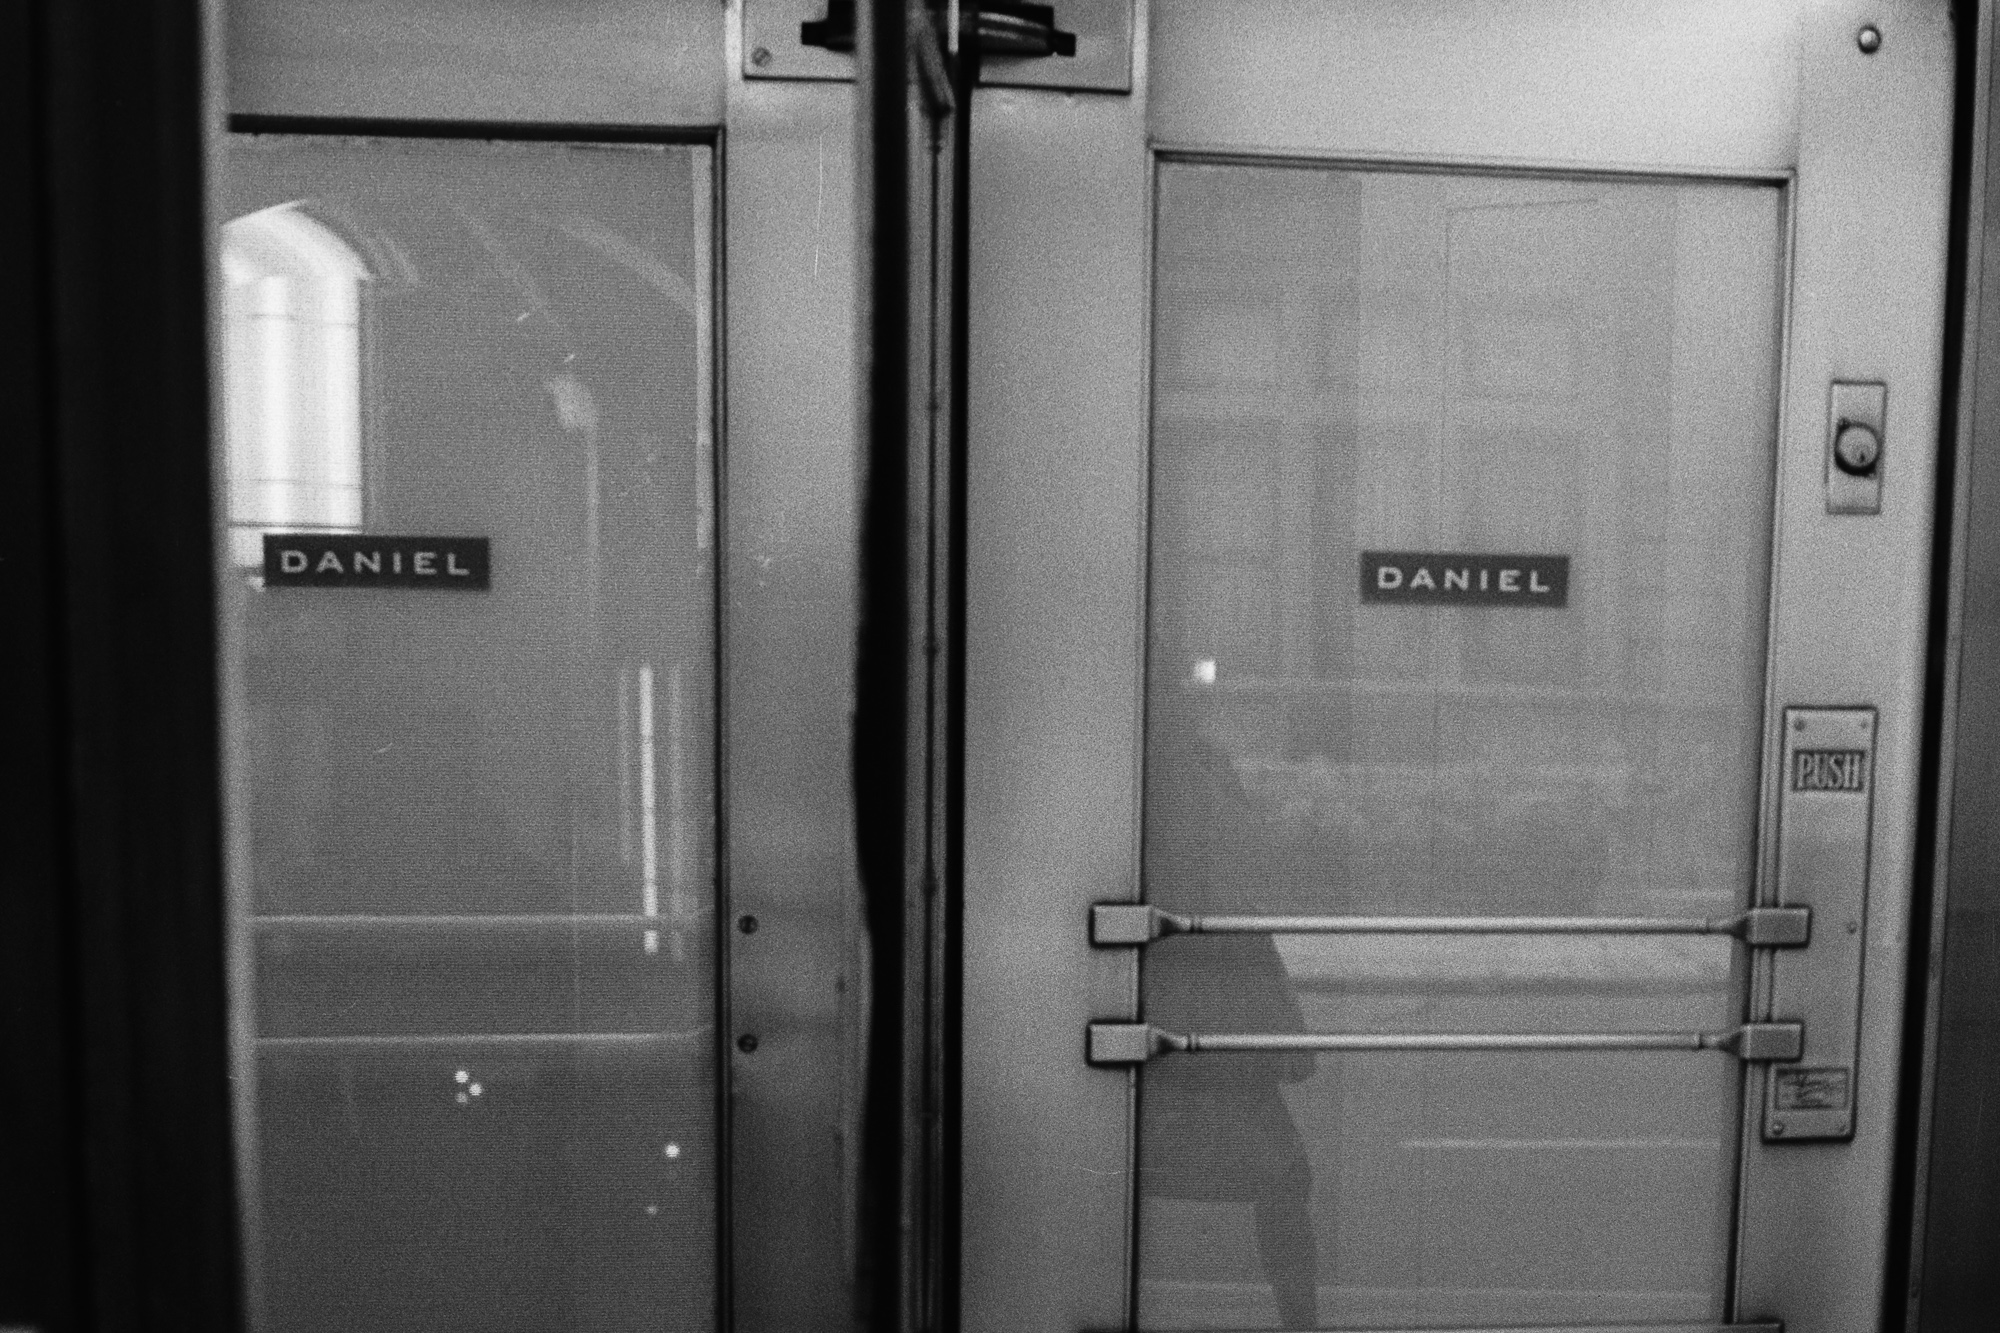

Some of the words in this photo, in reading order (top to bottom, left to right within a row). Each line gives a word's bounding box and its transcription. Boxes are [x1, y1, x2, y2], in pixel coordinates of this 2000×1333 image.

[281, 550, 470, 576] DANIEL
[1377, 566, 1550, 592] DANIEL
[1797, 753, 1861, 788] PUSH
